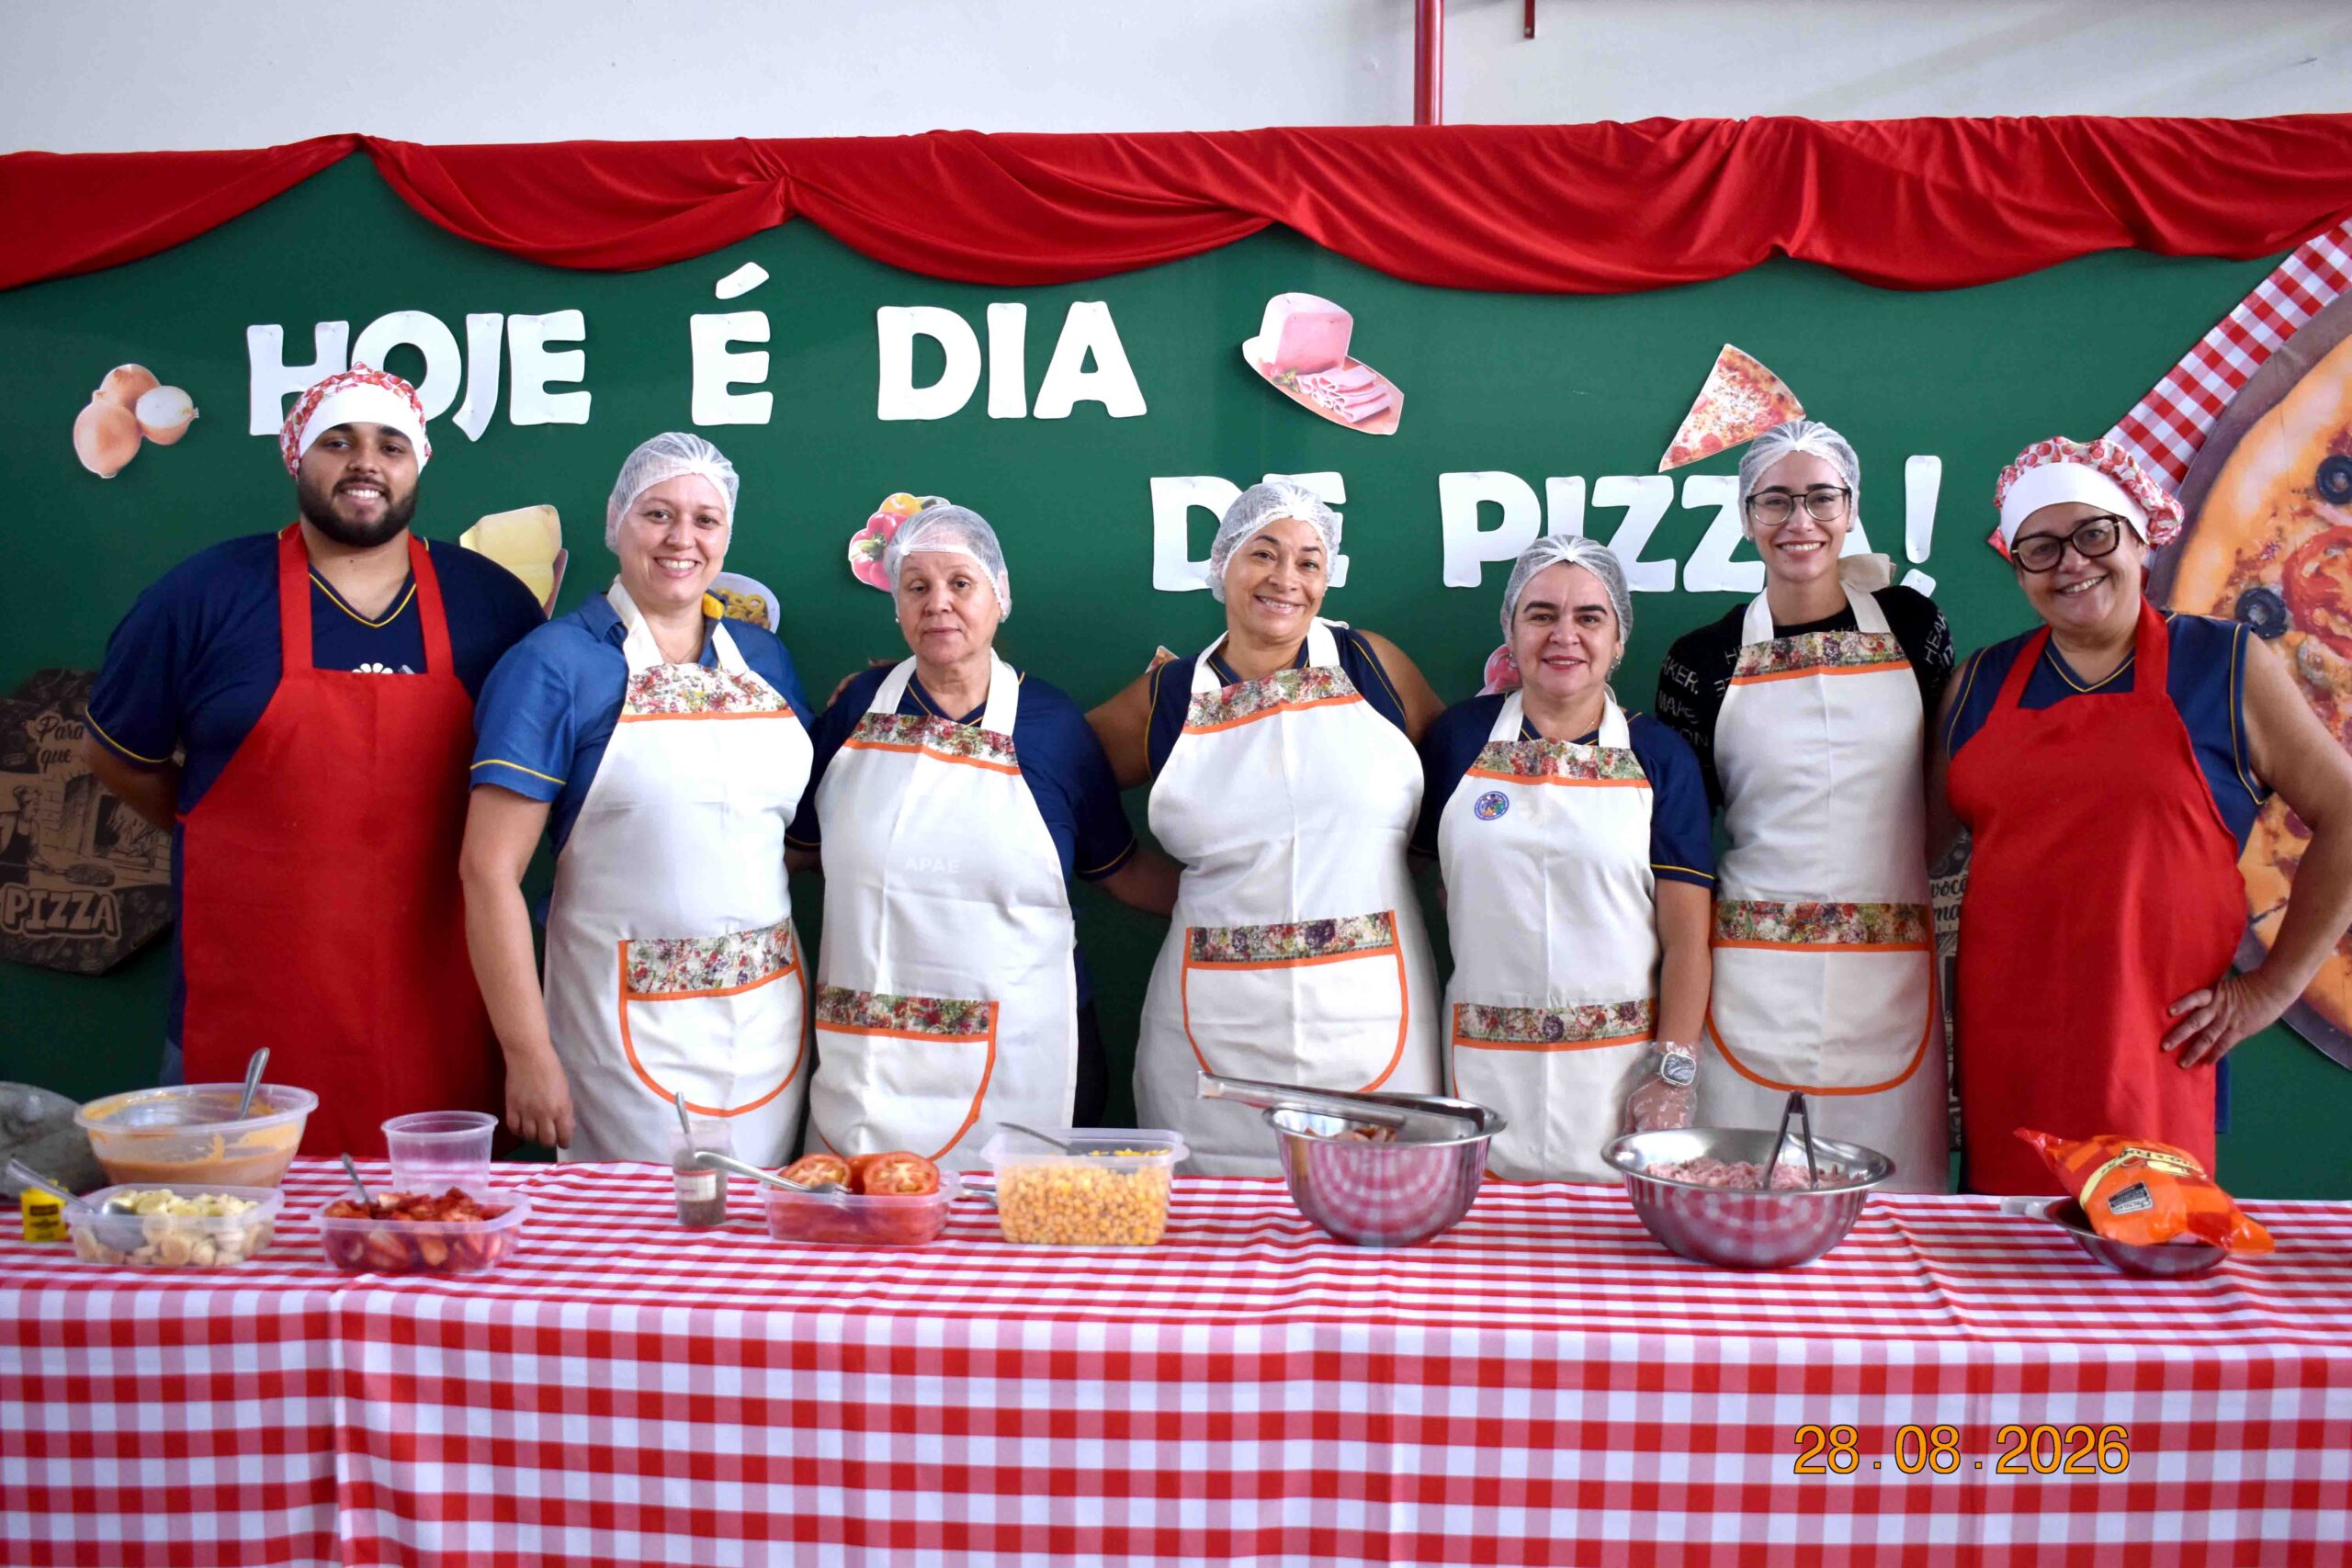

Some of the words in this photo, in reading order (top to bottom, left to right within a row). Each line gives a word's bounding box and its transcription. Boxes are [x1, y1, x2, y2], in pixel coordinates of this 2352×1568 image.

[246, 309, 592, 442] HOJE
[689, 262, 774, 425] É
[876, 301, 1148, 421] DIA
[1438, 455, 1942, 598] PIZZ!
[37, 715, 84, 744] Para
[40, 747, 73, 771] que
[904, 857, 961, 874] APAE
[4, 886, 119, 936] PIZZA
